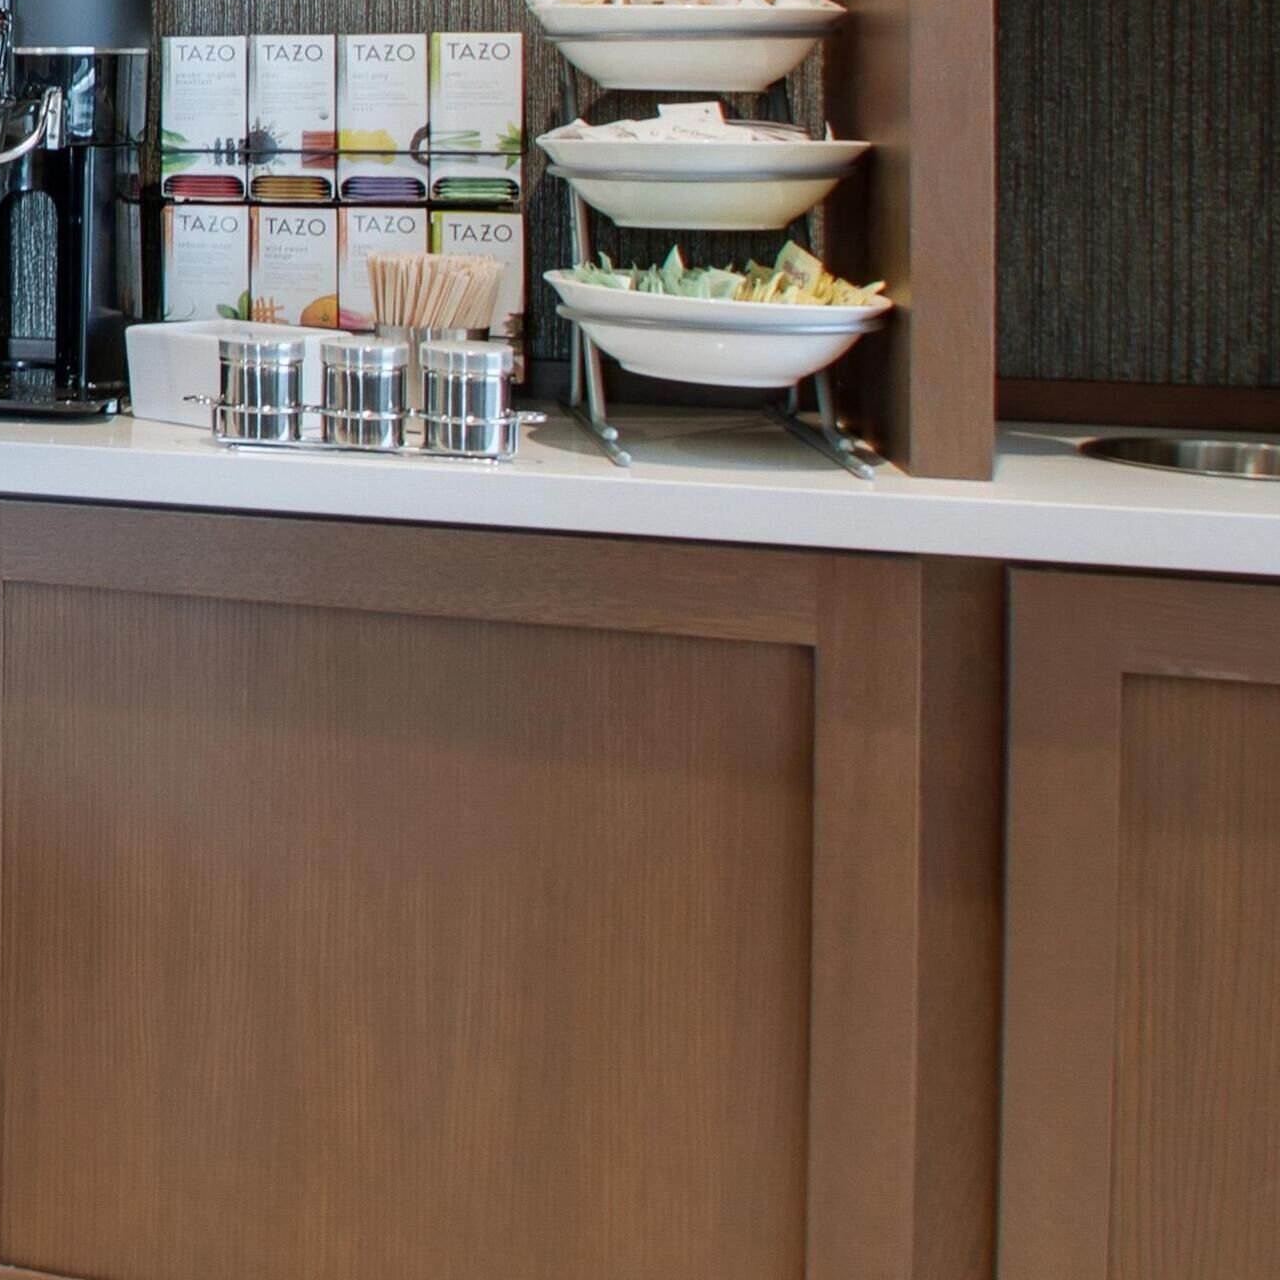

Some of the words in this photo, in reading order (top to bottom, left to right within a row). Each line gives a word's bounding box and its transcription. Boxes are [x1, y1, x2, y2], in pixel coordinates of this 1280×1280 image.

[176, 44, 236, 62] TAZO
[262, 44, 323, 62] TAZO
[352, 43, 416, 62] TAZO
[446, 42, 511, 60] TAZO
[178, 214, 239, 233] TAZO
[266, 217, 327, 236] TAZO
[353, 214, 416, 234] TAZO
[448, 224, 512, 242] TAZO
